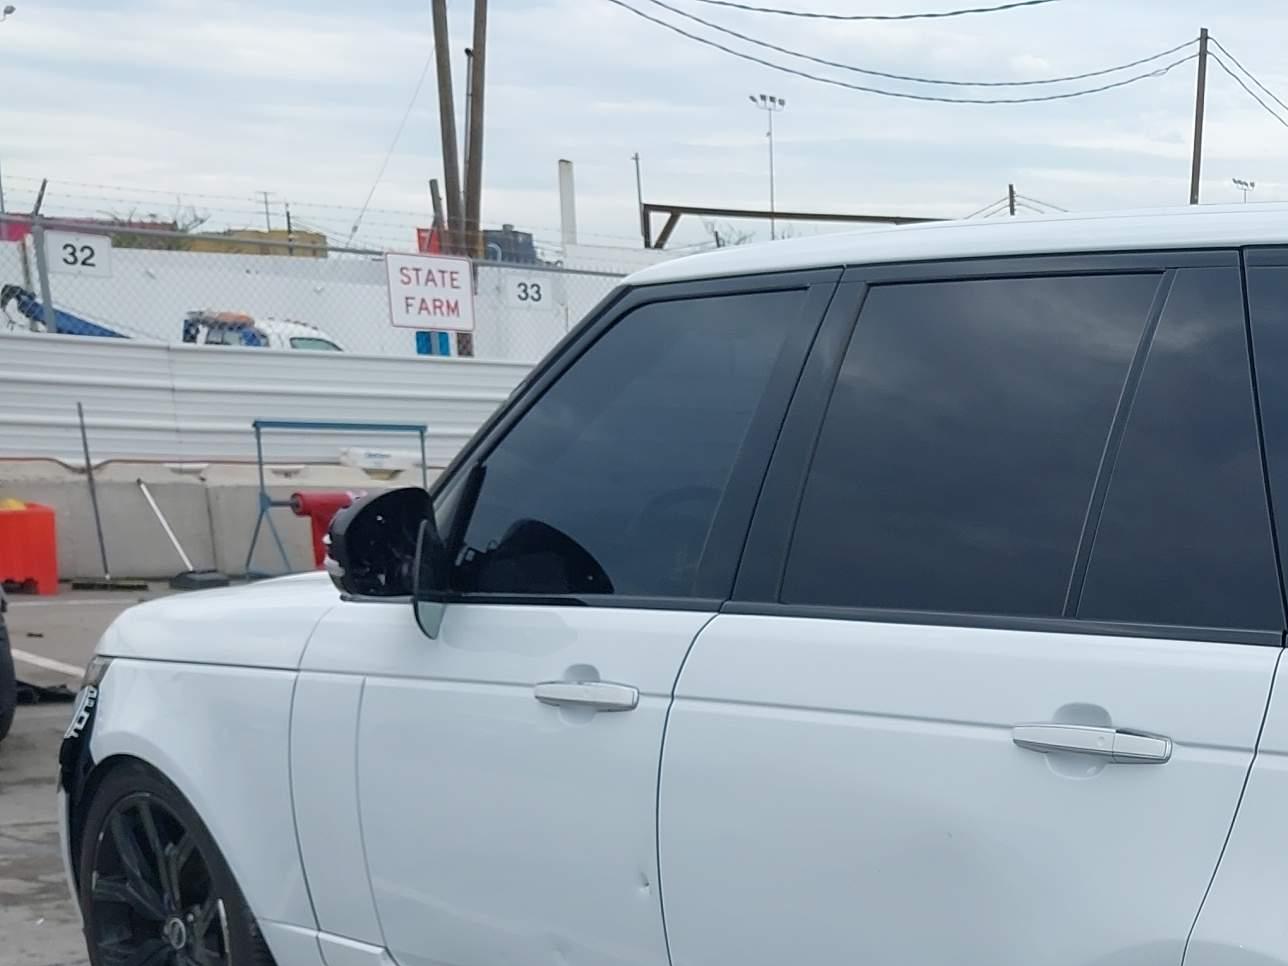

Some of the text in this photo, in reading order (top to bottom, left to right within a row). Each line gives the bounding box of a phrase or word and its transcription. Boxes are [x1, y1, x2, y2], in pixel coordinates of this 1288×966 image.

[62, 243, 96, 267] 32
[400, 266, 461, 289] STATE
[518, 282, 542, 302] 33
[405, 296, 460, 317] FARM
